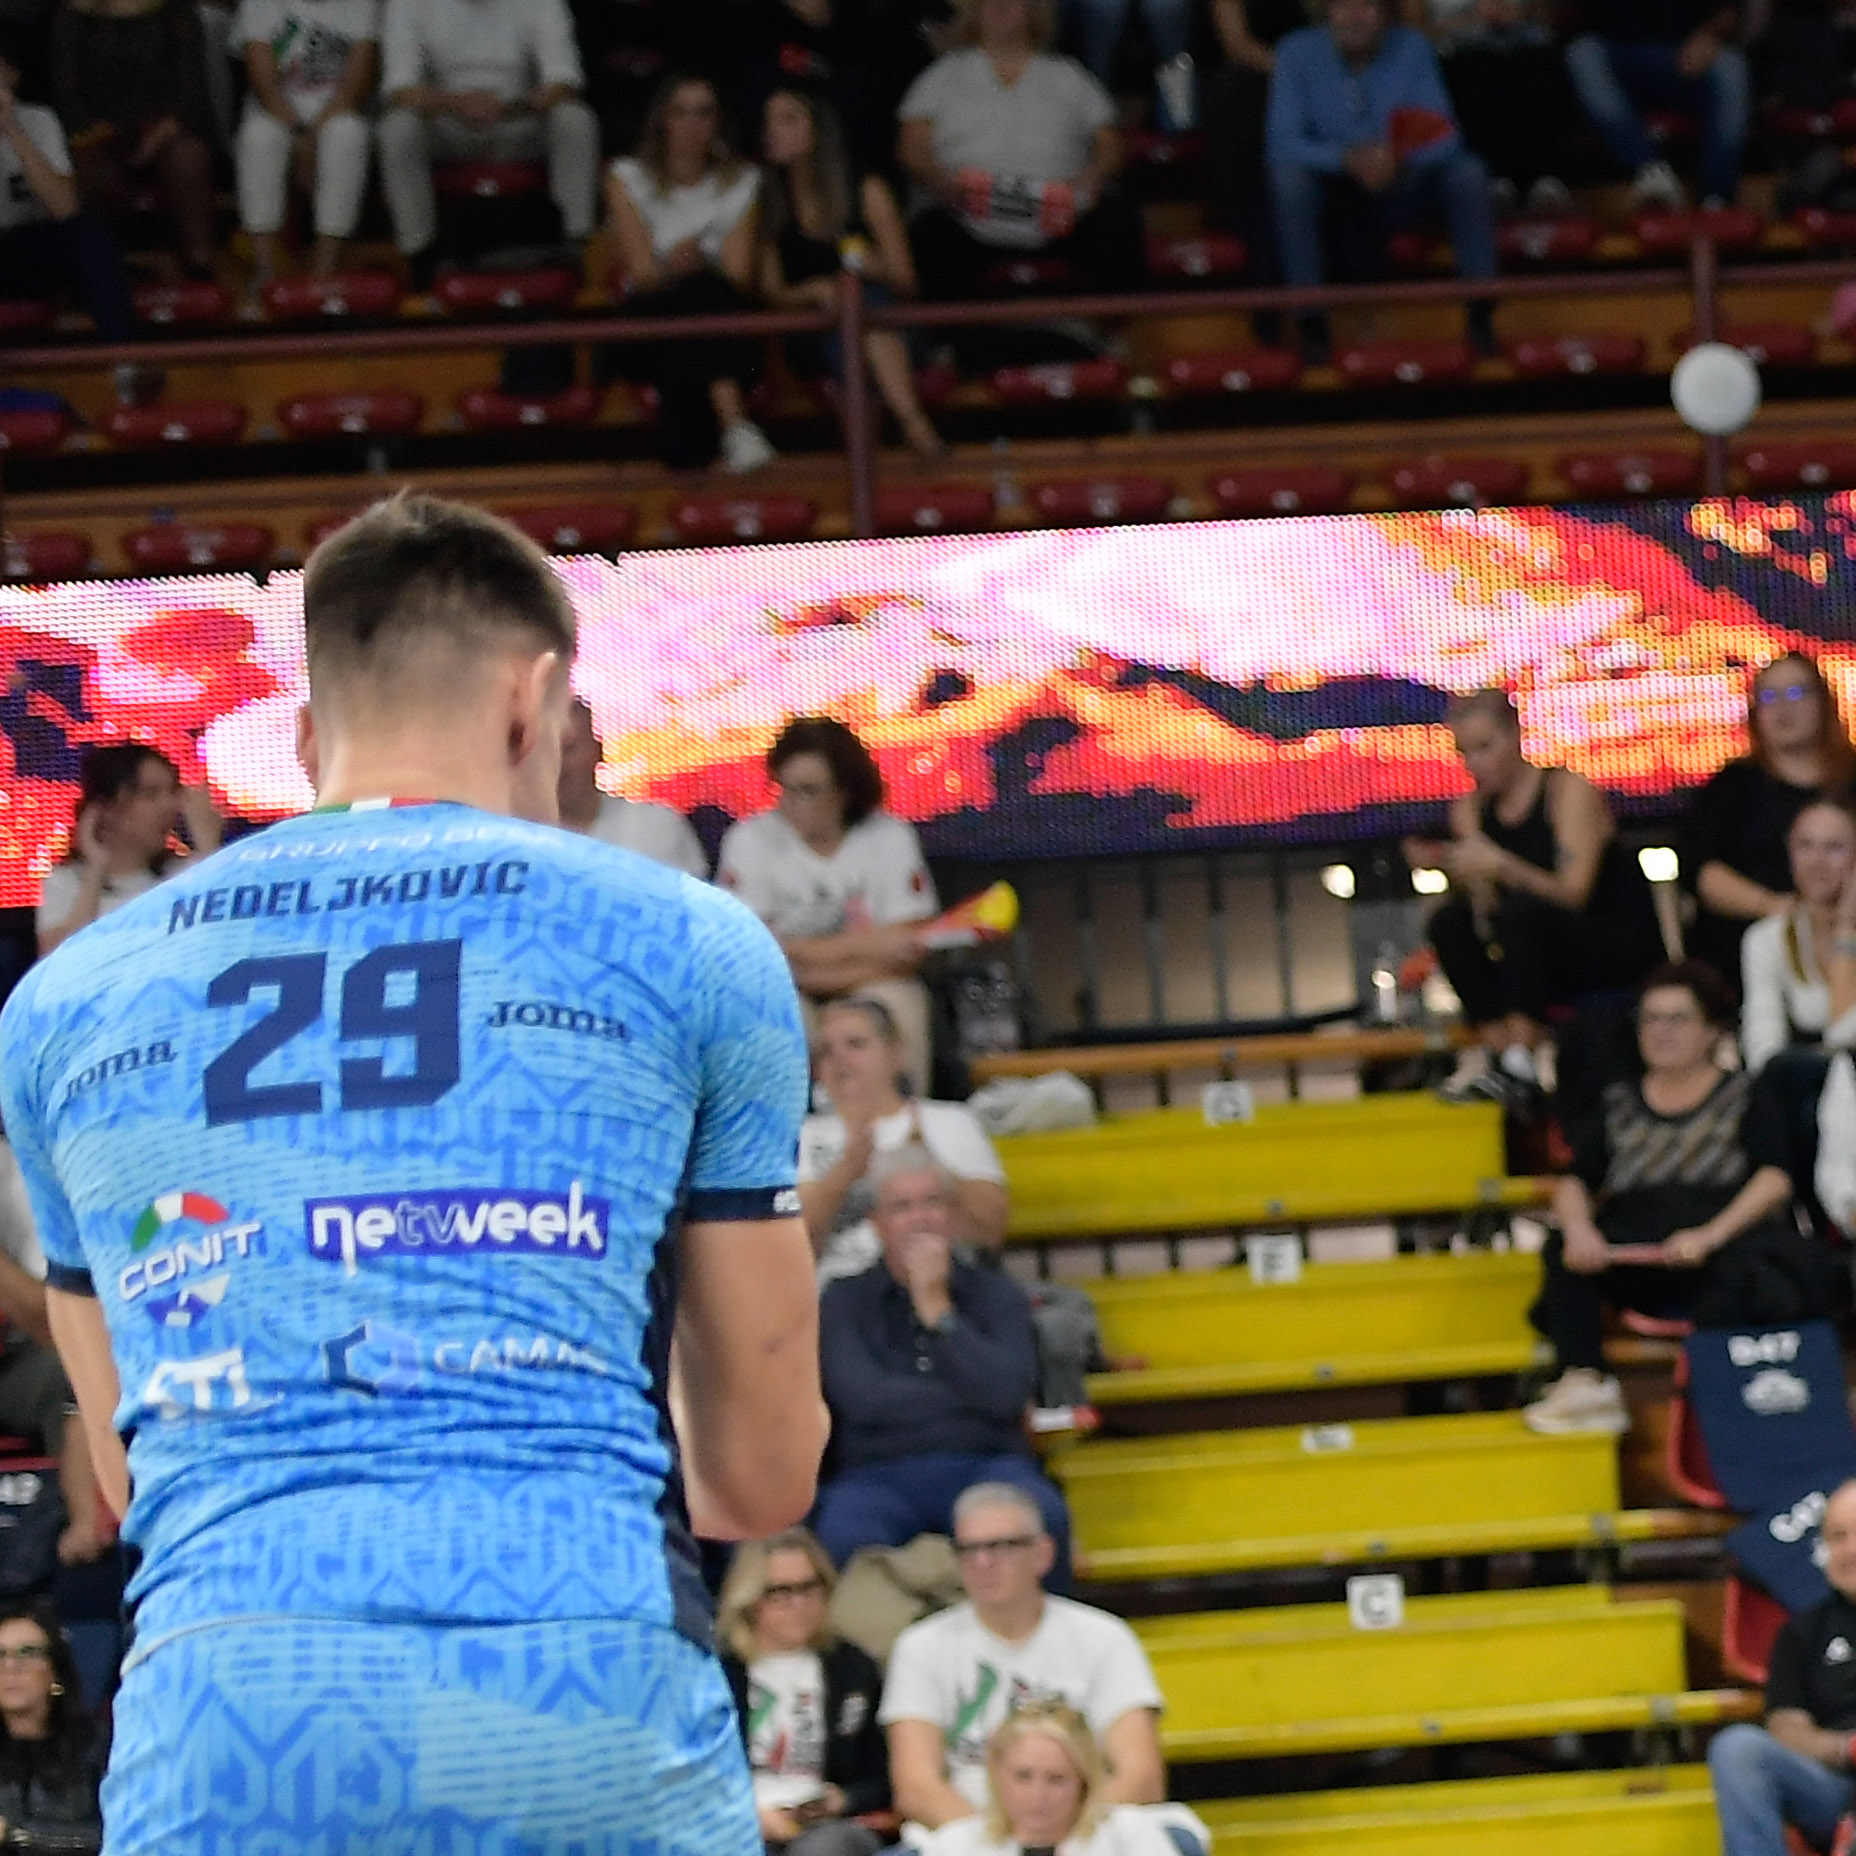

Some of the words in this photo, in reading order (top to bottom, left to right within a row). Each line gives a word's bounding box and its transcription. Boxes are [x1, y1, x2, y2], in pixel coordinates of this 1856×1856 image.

[167, 860, 531, 935] NEDELJKOVIC
[204, 938, 464, 1129] 29
[118, 1221, 263, 1302] CONIT
